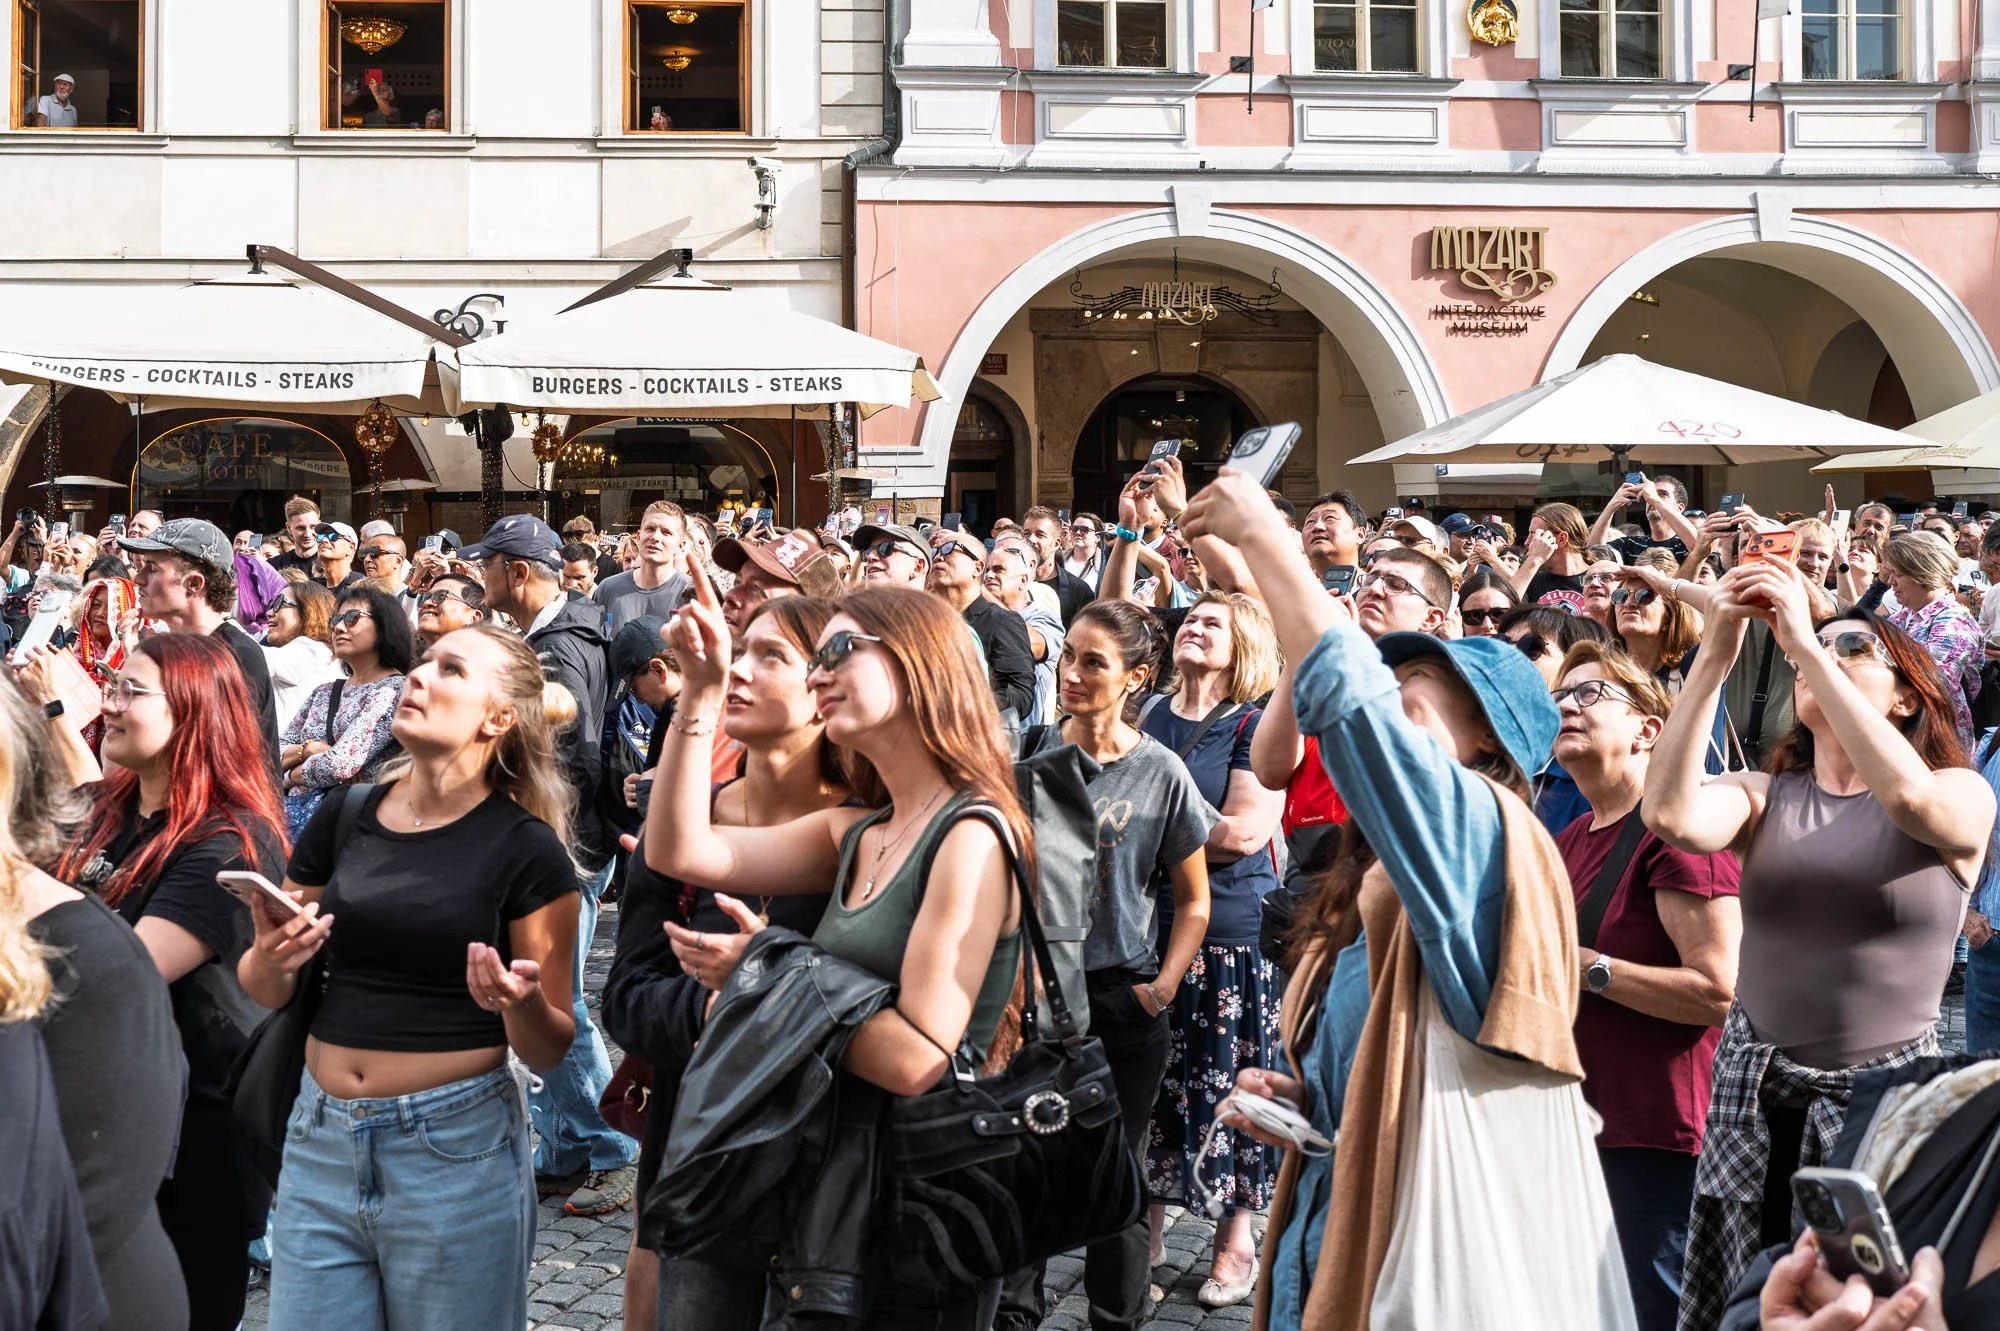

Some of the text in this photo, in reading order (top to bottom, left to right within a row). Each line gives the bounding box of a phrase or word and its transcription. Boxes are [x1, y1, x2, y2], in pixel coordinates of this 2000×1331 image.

[1431, 226, 1558, 299] MOZART
[1141, 282, 1219, 325] MOZART
[1435, 305, 1547, 318] INTERACTIVE
[1453, 322, 1528, 334] MUSEUM
[147, 368, 257, 388] COCKTAILS
[279, 372, 354, 389] STEAKS
[532, 376, 623, 395] BURGERS
[643, 377, 749, 395] COCKTAILS
[770, 376, 843, 392] STEAKS
